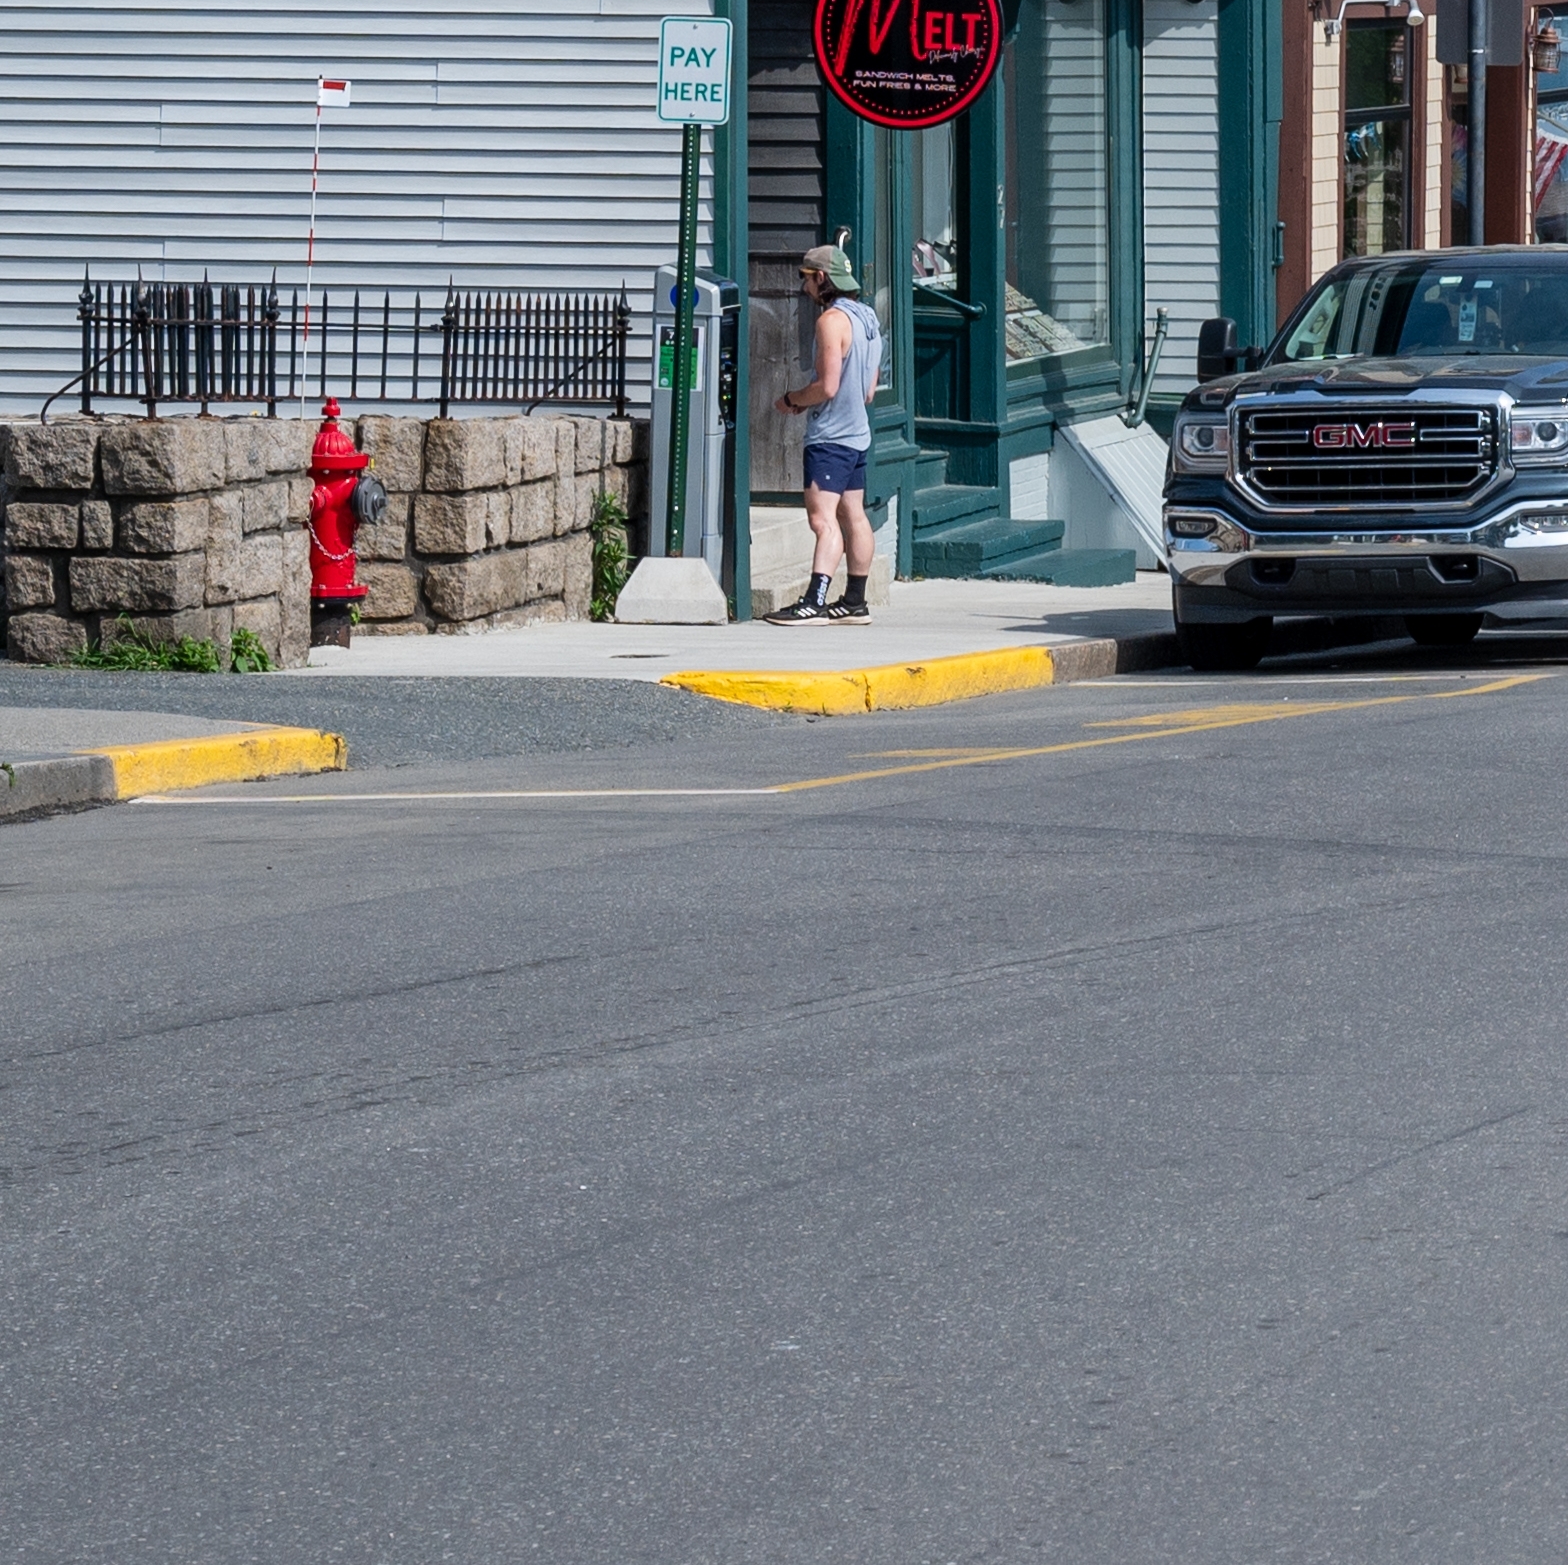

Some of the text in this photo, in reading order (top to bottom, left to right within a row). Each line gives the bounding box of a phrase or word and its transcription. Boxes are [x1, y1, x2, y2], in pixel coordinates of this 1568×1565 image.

[670, 46, 717, 68] PAY
[855, 70, 913, 80] SANDWICH
[664, 82, 722, 102] HERE
[853, 80, 877, 88] FUN
[879, 81, 911, 90] FRIES
[925, 84, 957, 92] MORE
[1313, 422, 1415, 448] GMC
